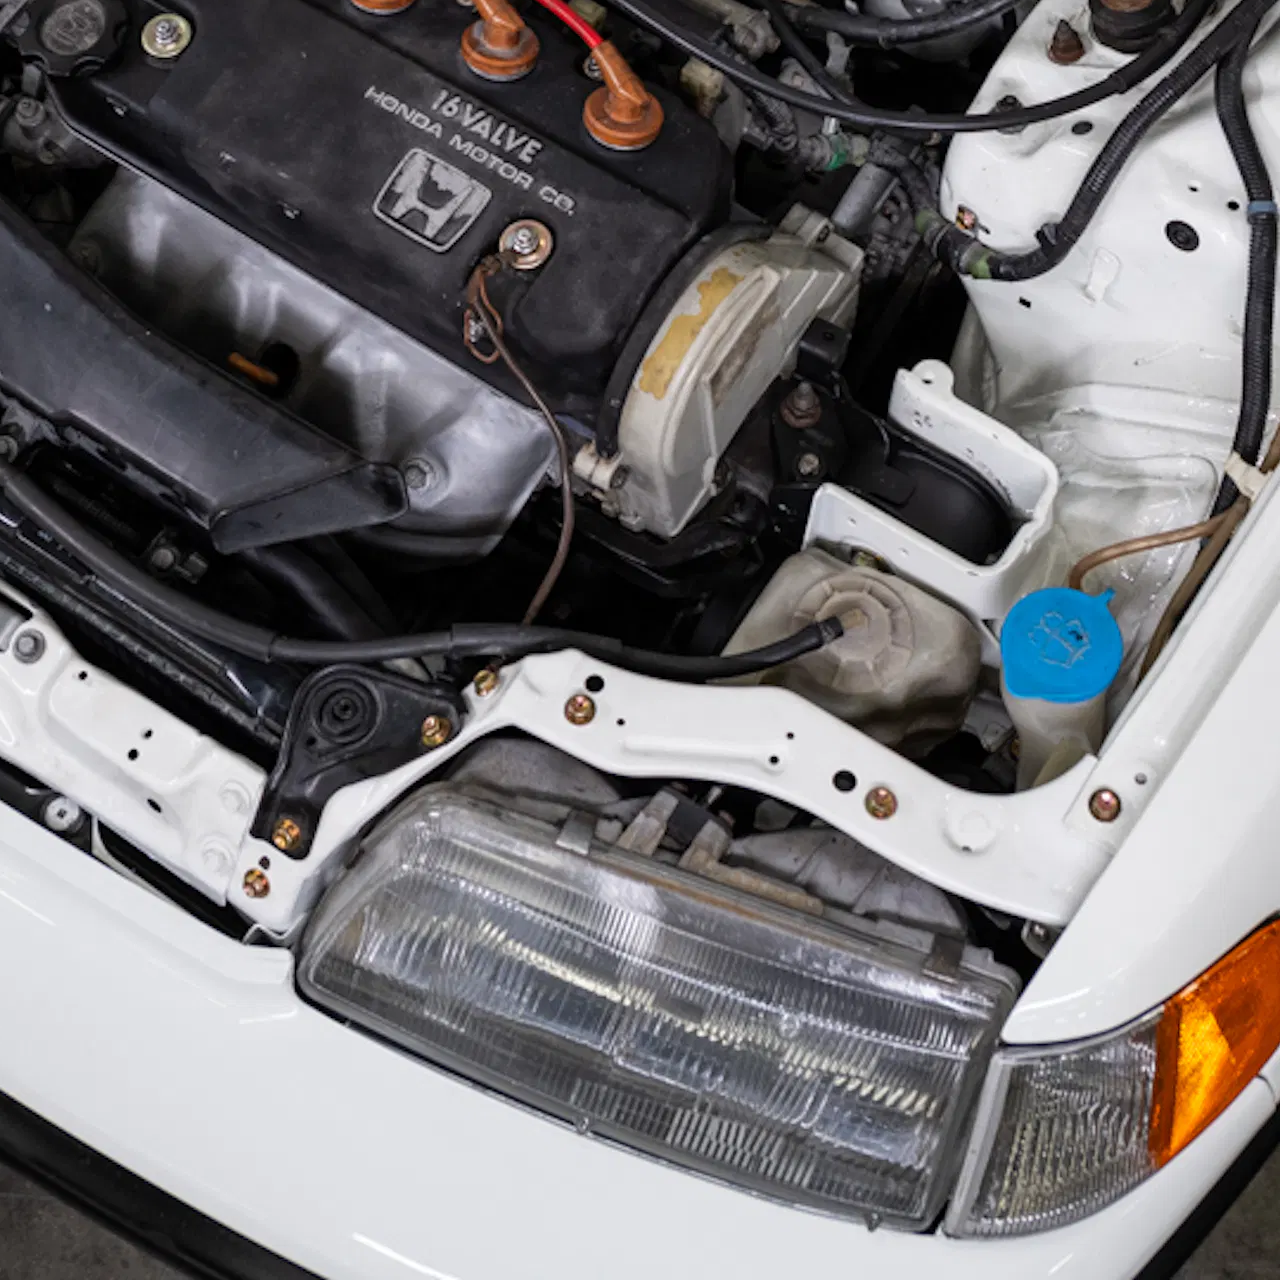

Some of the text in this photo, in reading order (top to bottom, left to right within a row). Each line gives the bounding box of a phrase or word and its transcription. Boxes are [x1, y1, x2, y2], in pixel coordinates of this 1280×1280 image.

[363, 85, 577, 217] HONDA MOTOR CO.
